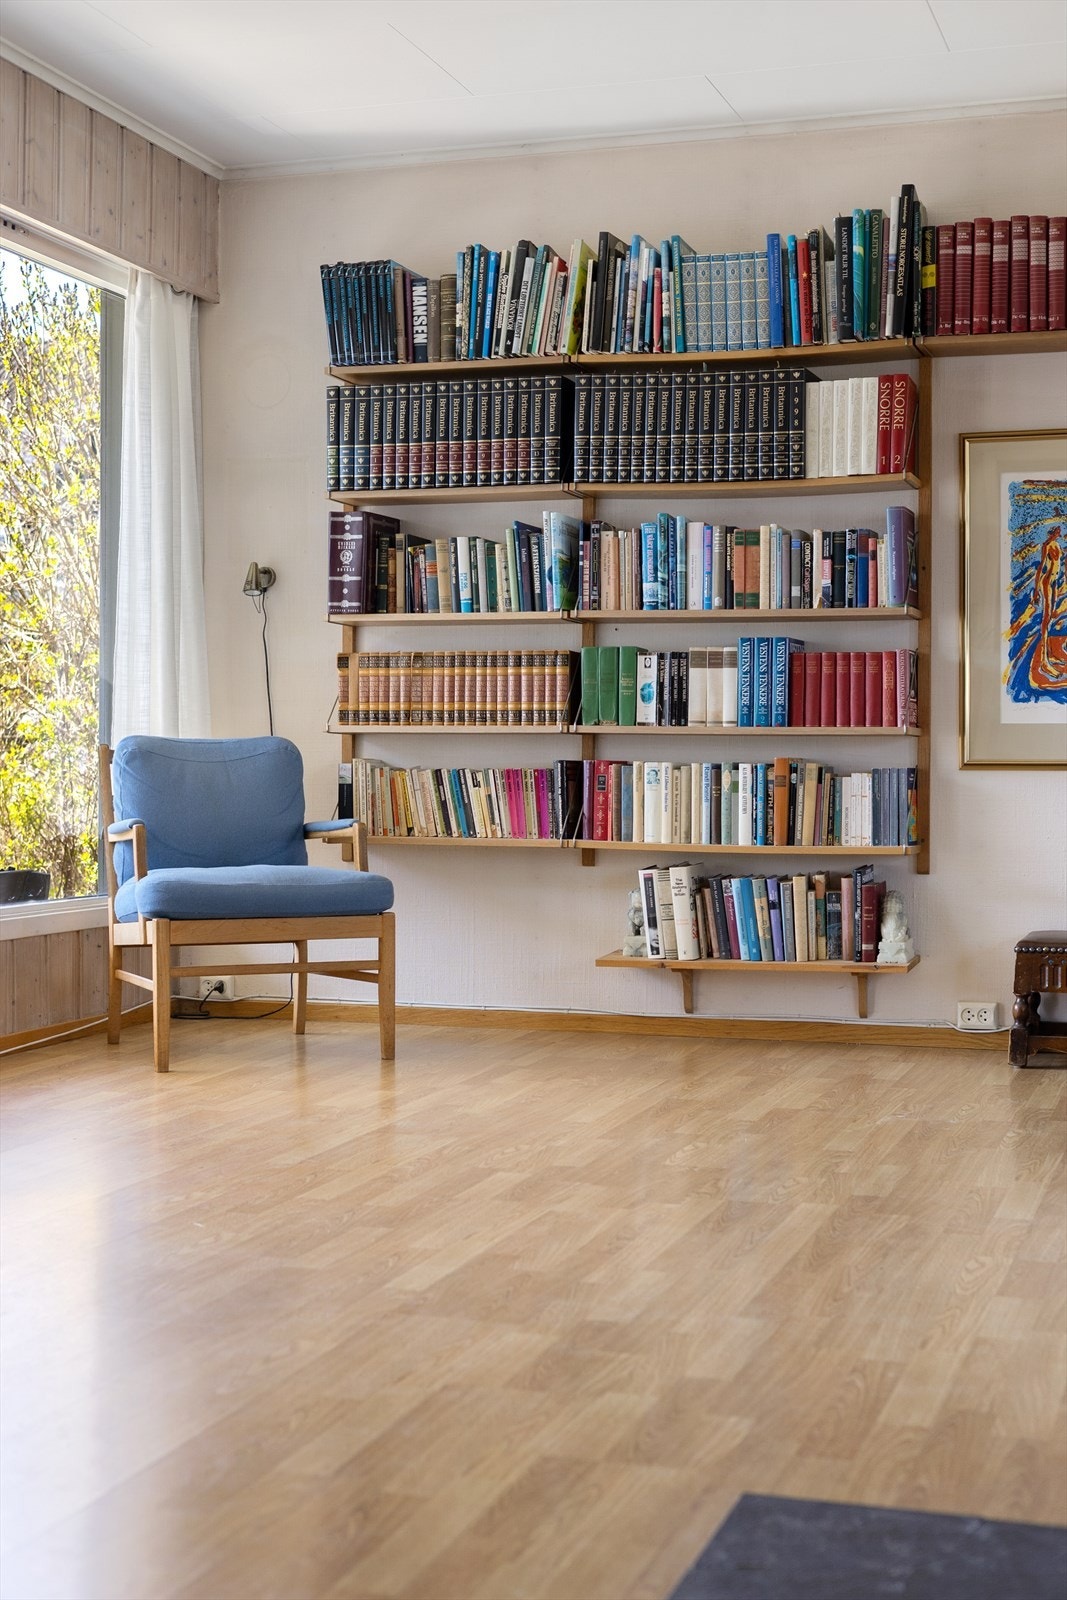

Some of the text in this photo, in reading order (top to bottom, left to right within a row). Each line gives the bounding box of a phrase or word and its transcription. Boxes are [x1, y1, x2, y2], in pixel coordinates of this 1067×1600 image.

[897, 250, 905, 296] NORGESATLAS
[412, 286, 427, 344] NANSEN
[498, 294, 506, 328] Storbritannia
[507, 299, 517, 330] ROMANIA
[519, 291, 527, 318] LØFTERIKE
[515, 319, 524, 339] LANDET
[880, 382, 891, 431] SNORRE
[894, 381, 905, 430] SNORRE
[881, 456, 885, 465] 1
[895, 455, 900, 464] 2
[741, 642, 750, 706] VESTENS TENKERE
[758, 642, 768, 706] VESTENS TENKERE
[776, 641, 785, 705] VESTENS TENKERE
